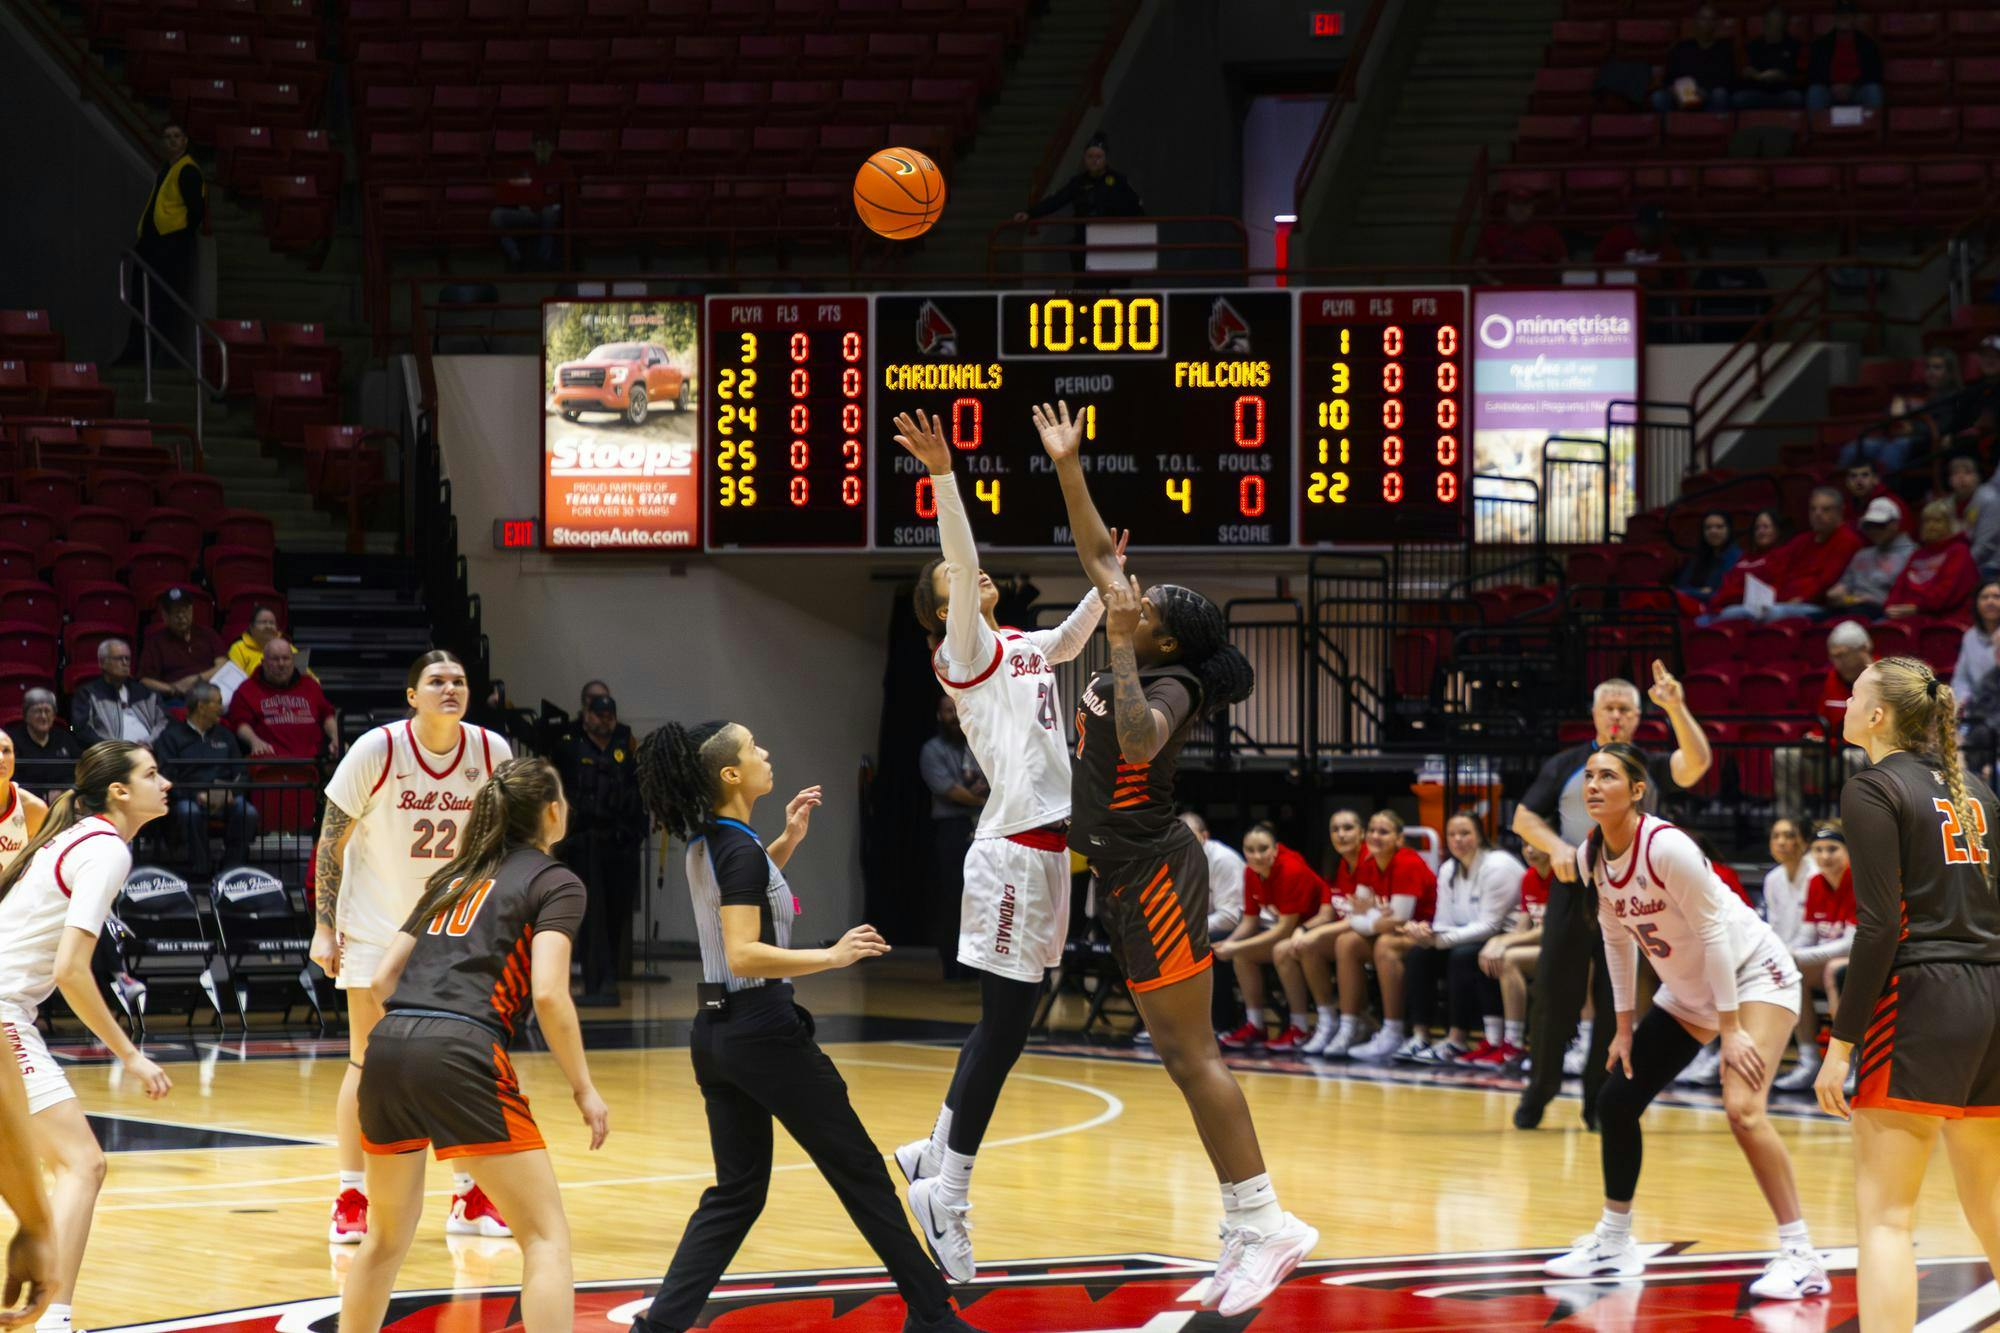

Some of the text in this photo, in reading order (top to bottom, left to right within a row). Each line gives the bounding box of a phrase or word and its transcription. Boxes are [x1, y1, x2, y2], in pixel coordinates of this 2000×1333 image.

[731, 305, 842, 323] PLYR FLS PTS
[1322, 298, 1437, 316] PLYR FLS PTS
[1028, 298, 1159, 352] 10:00
[1516, 314, 1631, 335] minnetrista
[741, 332, 862, 363] 3 0 0
[1340, 325, 1457, 356] 1 0 0
[717, 368, 862, 399] 22 0 0
[886, 363, 1003, 390] CARDINALS
[1055, 375, 1113, 395] PERIOD
[1174, 361, 1271, 388] FALCONS
[1331, 362, 1457, 394] 3 0 0
[717, 404, 862, 435] 24 0 0
[952, 397, 983, 450] 0
[1086, 404, 1097, 441] 1
[1233, 396, 1265, 448] 0
[1318, 399, 1457, 431] 10 0 0
[550, 438, 693, 477] Stoops
[717, 440, 758, 471] 25
[790, 440, 809, 471] 0
[967, 455, 1011, 474] T.O.L.
[1097, 455, 1138, 473] FOUL
[1156, 454, 1202, 472] T.O.L.
[1218, 454, 1272, 473] FOULS
[1318, 435, 1457, 466] 11 0 0
[565, 493, 677, 506] TEAM BALL STATE
[573, 482, 669, 494] PROUD PARTNER OF
[719, 475, 862, 507] 35 0 0
[915, 476, 938, 519] 0
[976, 479, 1000, 515] 4
[1165, 478, 1192, 515] 4
[1240, 475, 1265, 517] 0
[1307, 471, 1457, 504] 22 0 0
[572, 506, 591, 517] FOR
[594, 506, 620, 517] OVER
[504, 520, 533, 547] EXIT
[552, 527, 689, 549] StoopsAuto.com
[1218, 524, 1272, 544] SCORE
[396, 790, 474, 811] Ball State
[411, 818, 457, 858] 22
[1932, 797, 1990, 864] 22
[427, 877, 496, 936] 10
[995, 884, 1015, 955] CARDINALS
[1630, 896, 1666, 917] State
